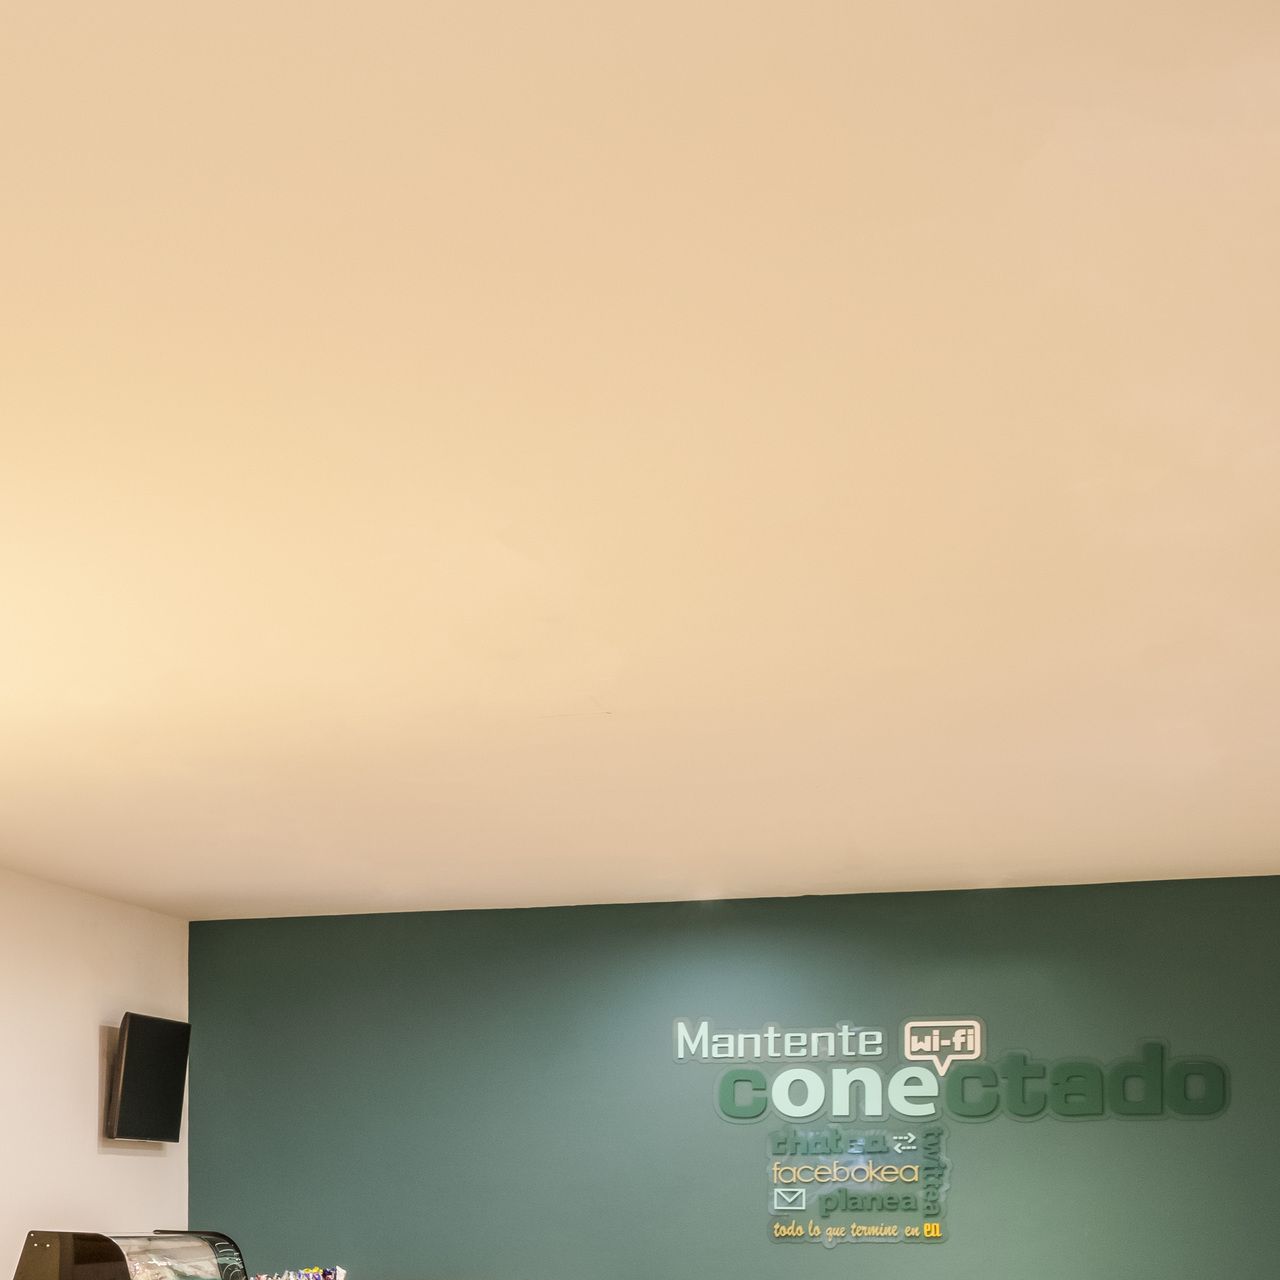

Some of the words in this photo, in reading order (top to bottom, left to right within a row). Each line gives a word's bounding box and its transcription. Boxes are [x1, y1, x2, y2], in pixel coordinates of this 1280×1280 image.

[677, 1021, 883, 1059] Mantente
[910, 1028, 975, 1052] wi-fi
[718, 1042, 1226, 1118] conectado
[771, 1130, 890, 1155] chatea
[772, 1160, 920, 1184] facebokea
[819, 1188, 918, 1219] planea
[773, 1219, 805, 1238] todo
[808, 1220, 821, 1237] lo
[825, 1224, 846, 1242] que
[850, 1221, 899, 1238] termine
[904, 1224, 920, 1238] en
[923, 1222, 942, 1238] ea
